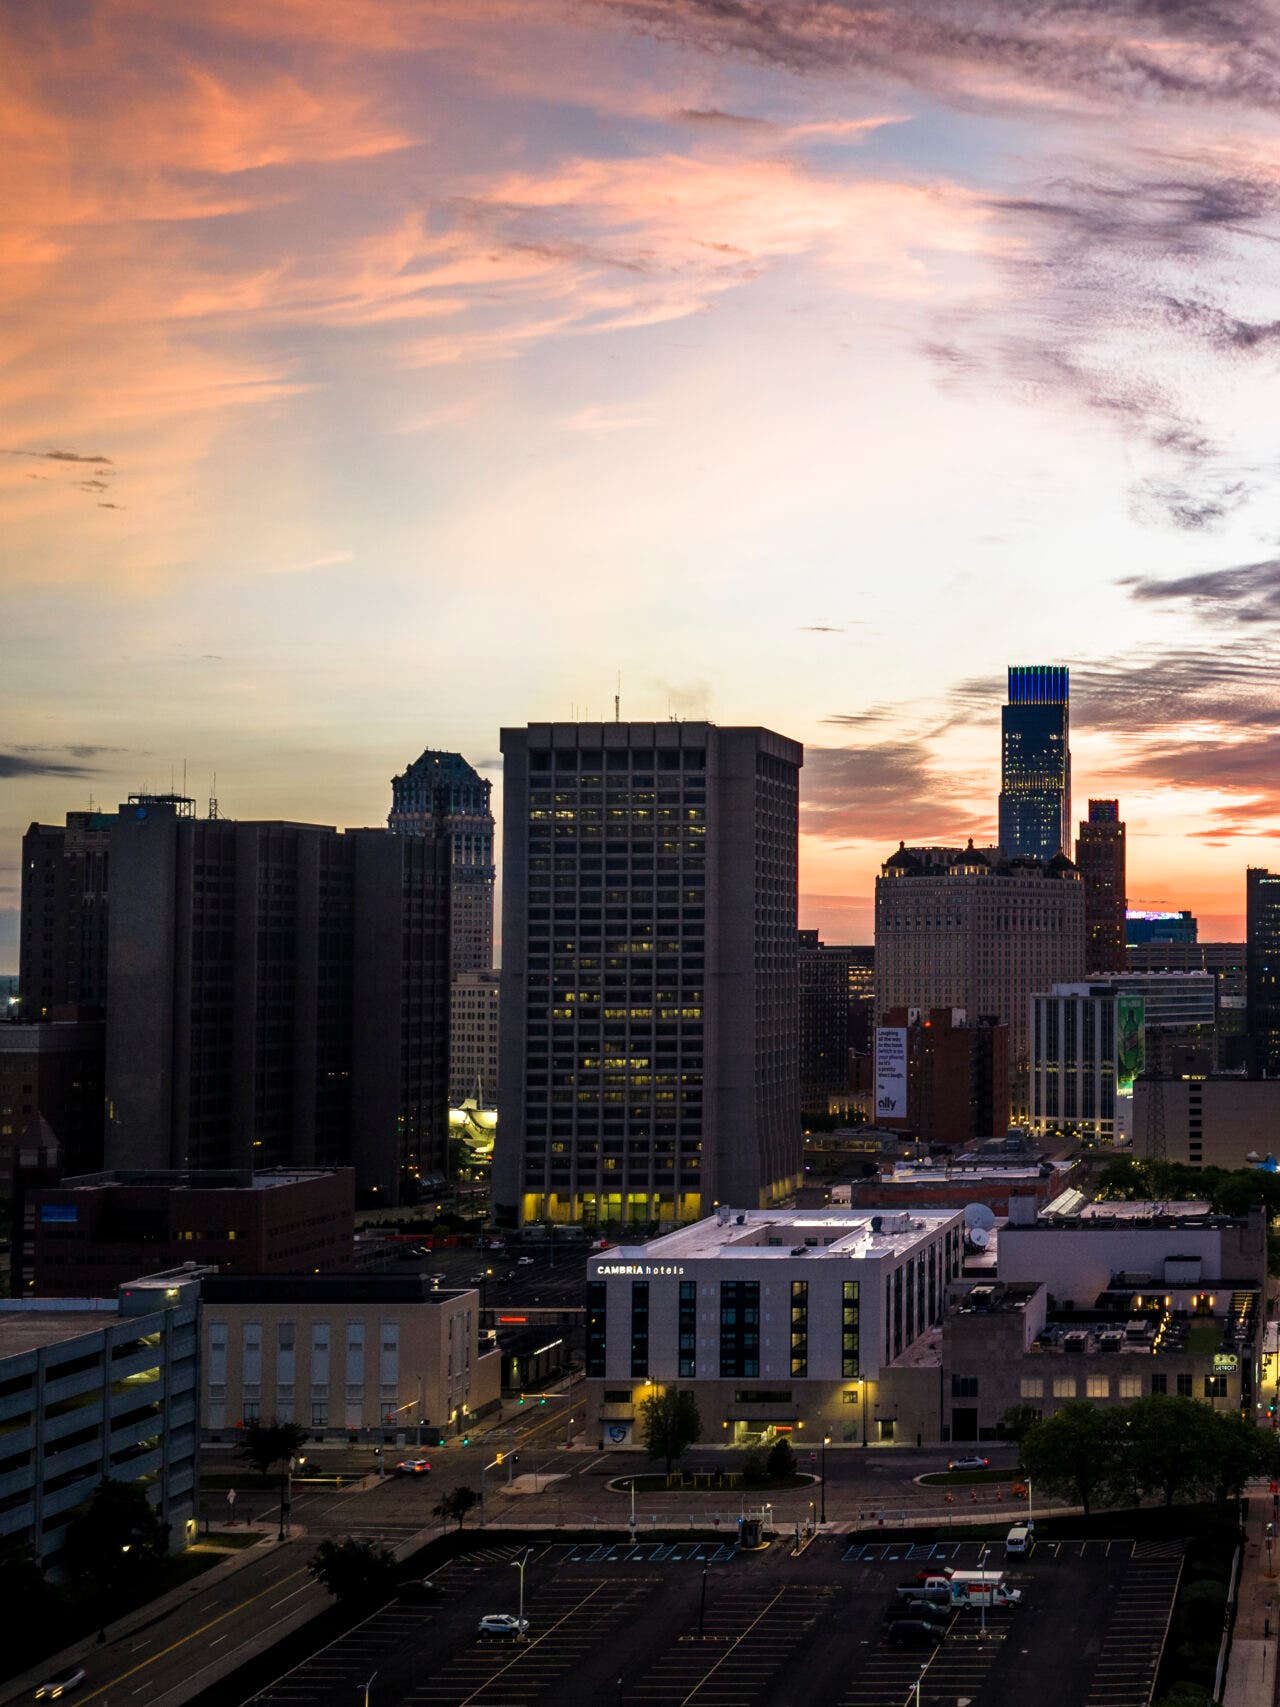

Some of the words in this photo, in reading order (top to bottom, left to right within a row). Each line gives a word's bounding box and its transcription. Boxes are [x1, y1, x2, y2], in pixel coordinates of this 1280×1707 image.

[878, 1097, 896, 1110] ally
[597, 1265, 643, 1275] CAMBRIA
[646, 1265, 684, 1275] hotels
